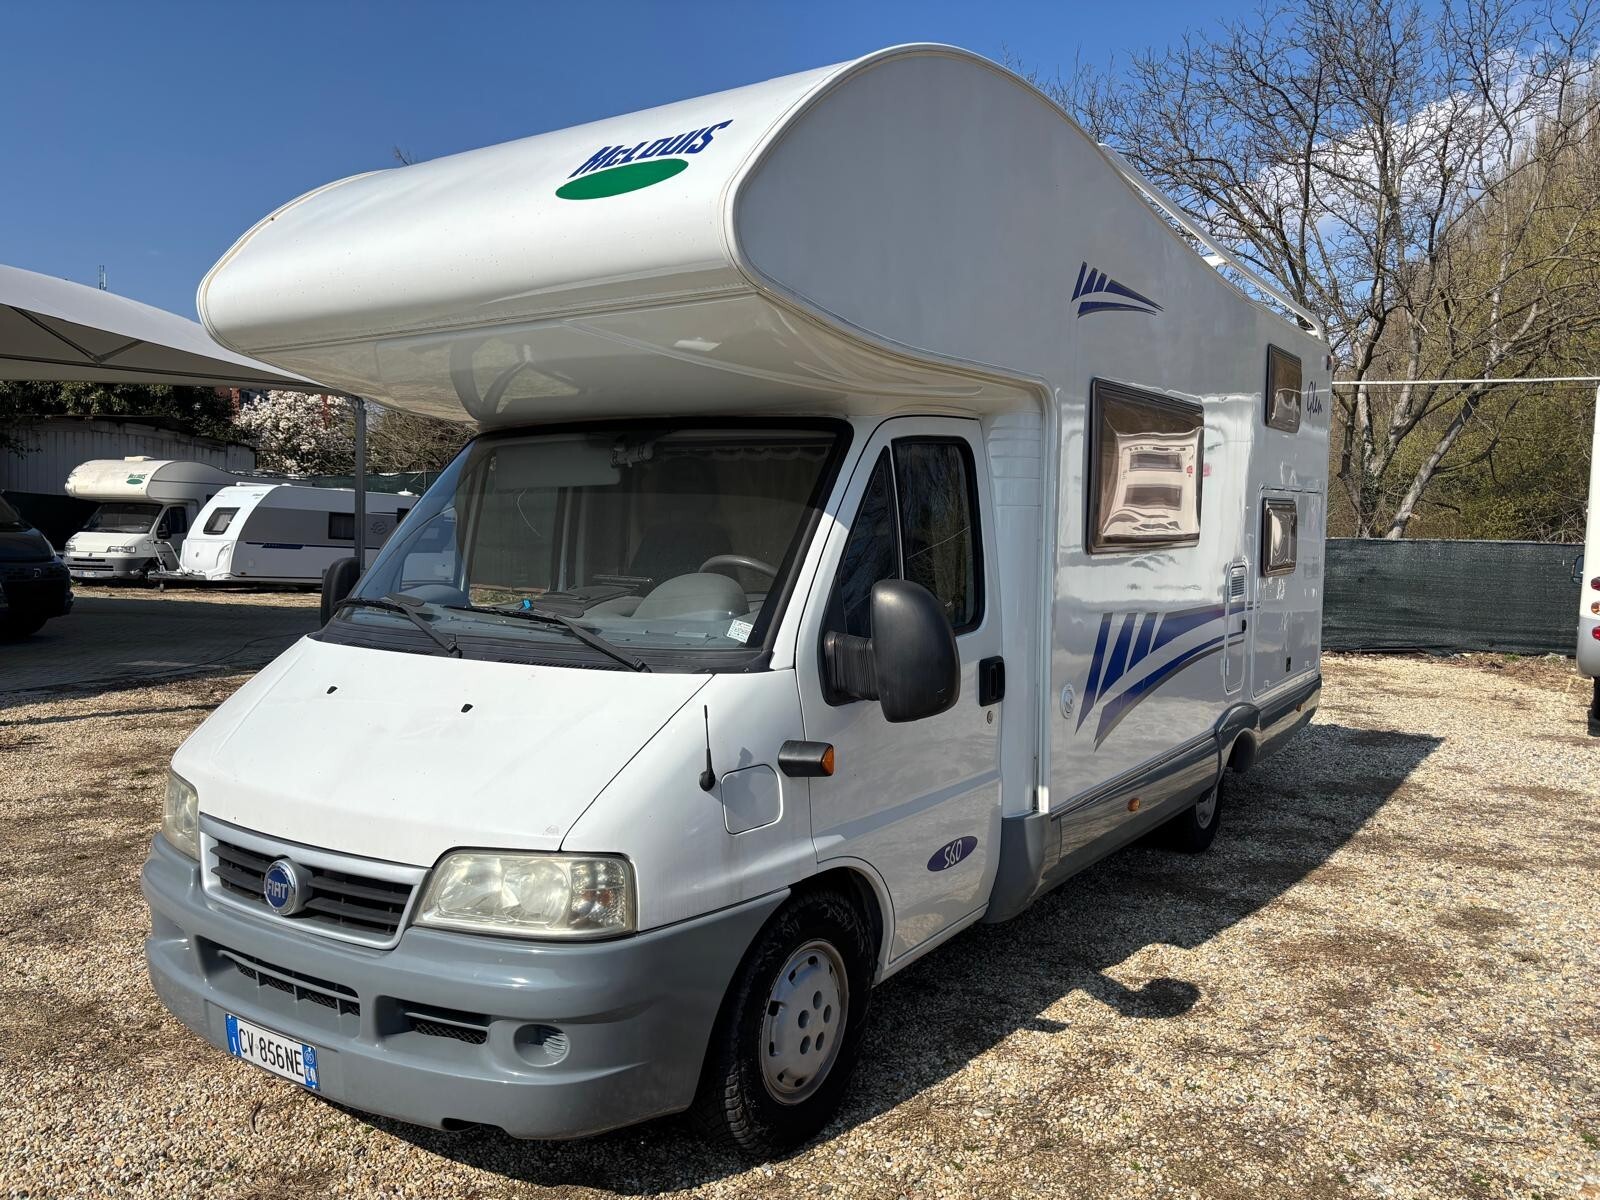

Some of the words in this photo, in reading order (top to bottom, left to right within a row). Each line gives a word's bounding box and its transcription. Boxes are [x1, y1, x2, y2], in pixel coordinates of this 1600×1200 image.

[267, 878, 288, 899] FIAT
[238, 1028, 254, 1057] CV
[259, 1036, 304, 1077] 856NE
